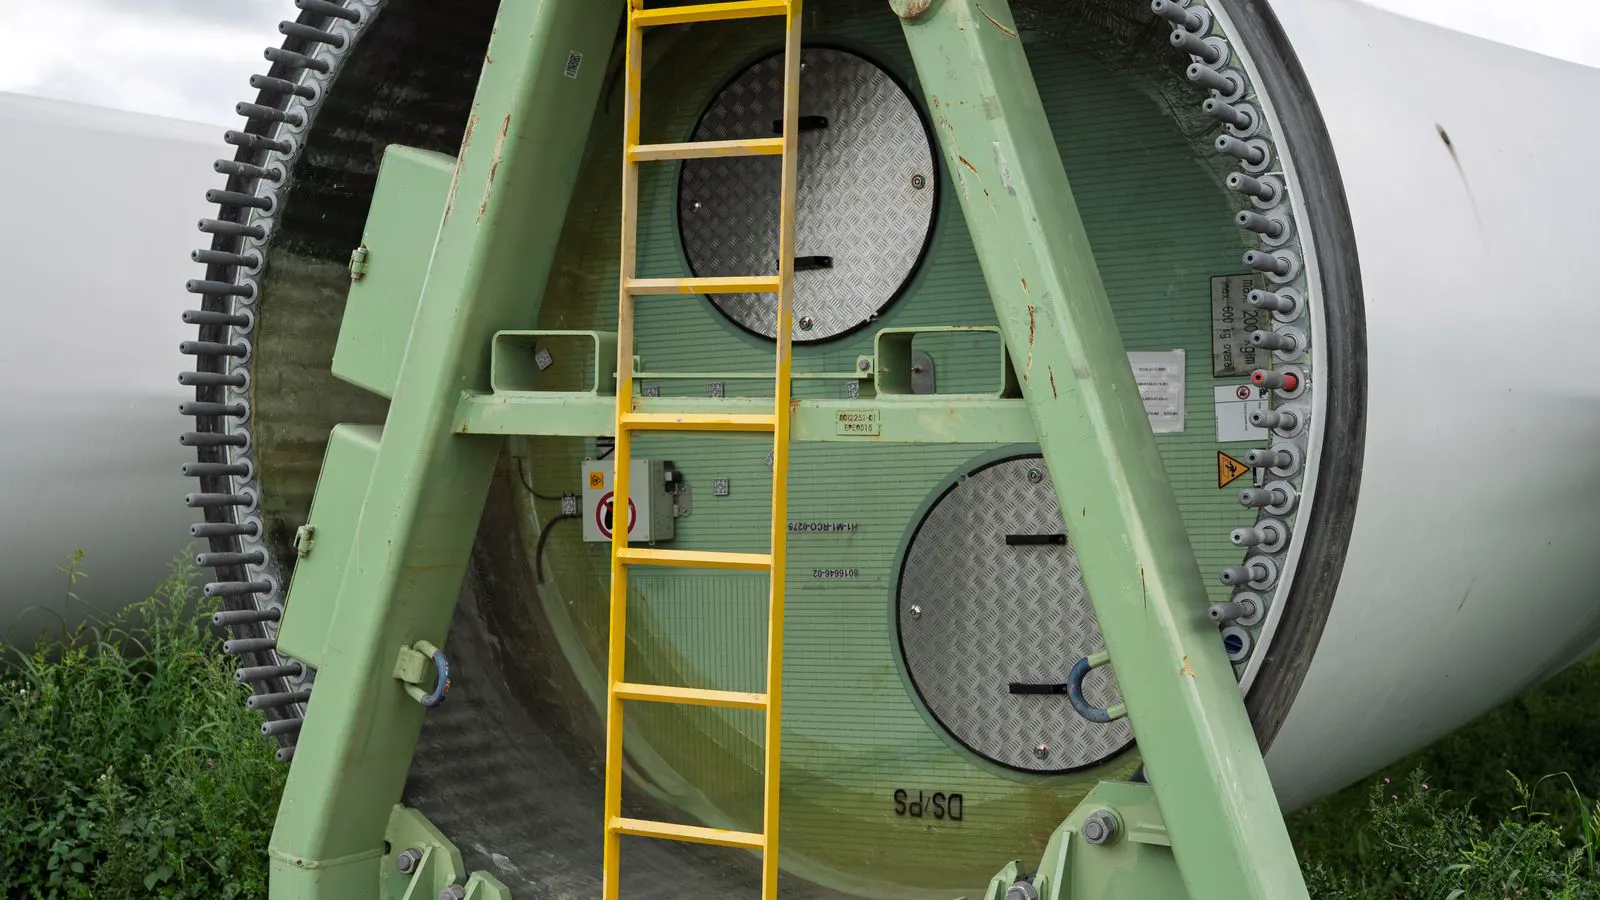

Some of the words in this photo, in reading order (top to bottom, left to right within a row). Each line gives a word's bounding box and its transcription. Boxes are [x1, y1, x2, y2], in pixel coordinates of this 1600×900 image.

[1222, 306, 1234, 323] 600
[1243, 310, 1259, 332] 200
[1220, 328, 1234, 339] kg
[894, 788, 963, 822] DS/PS
